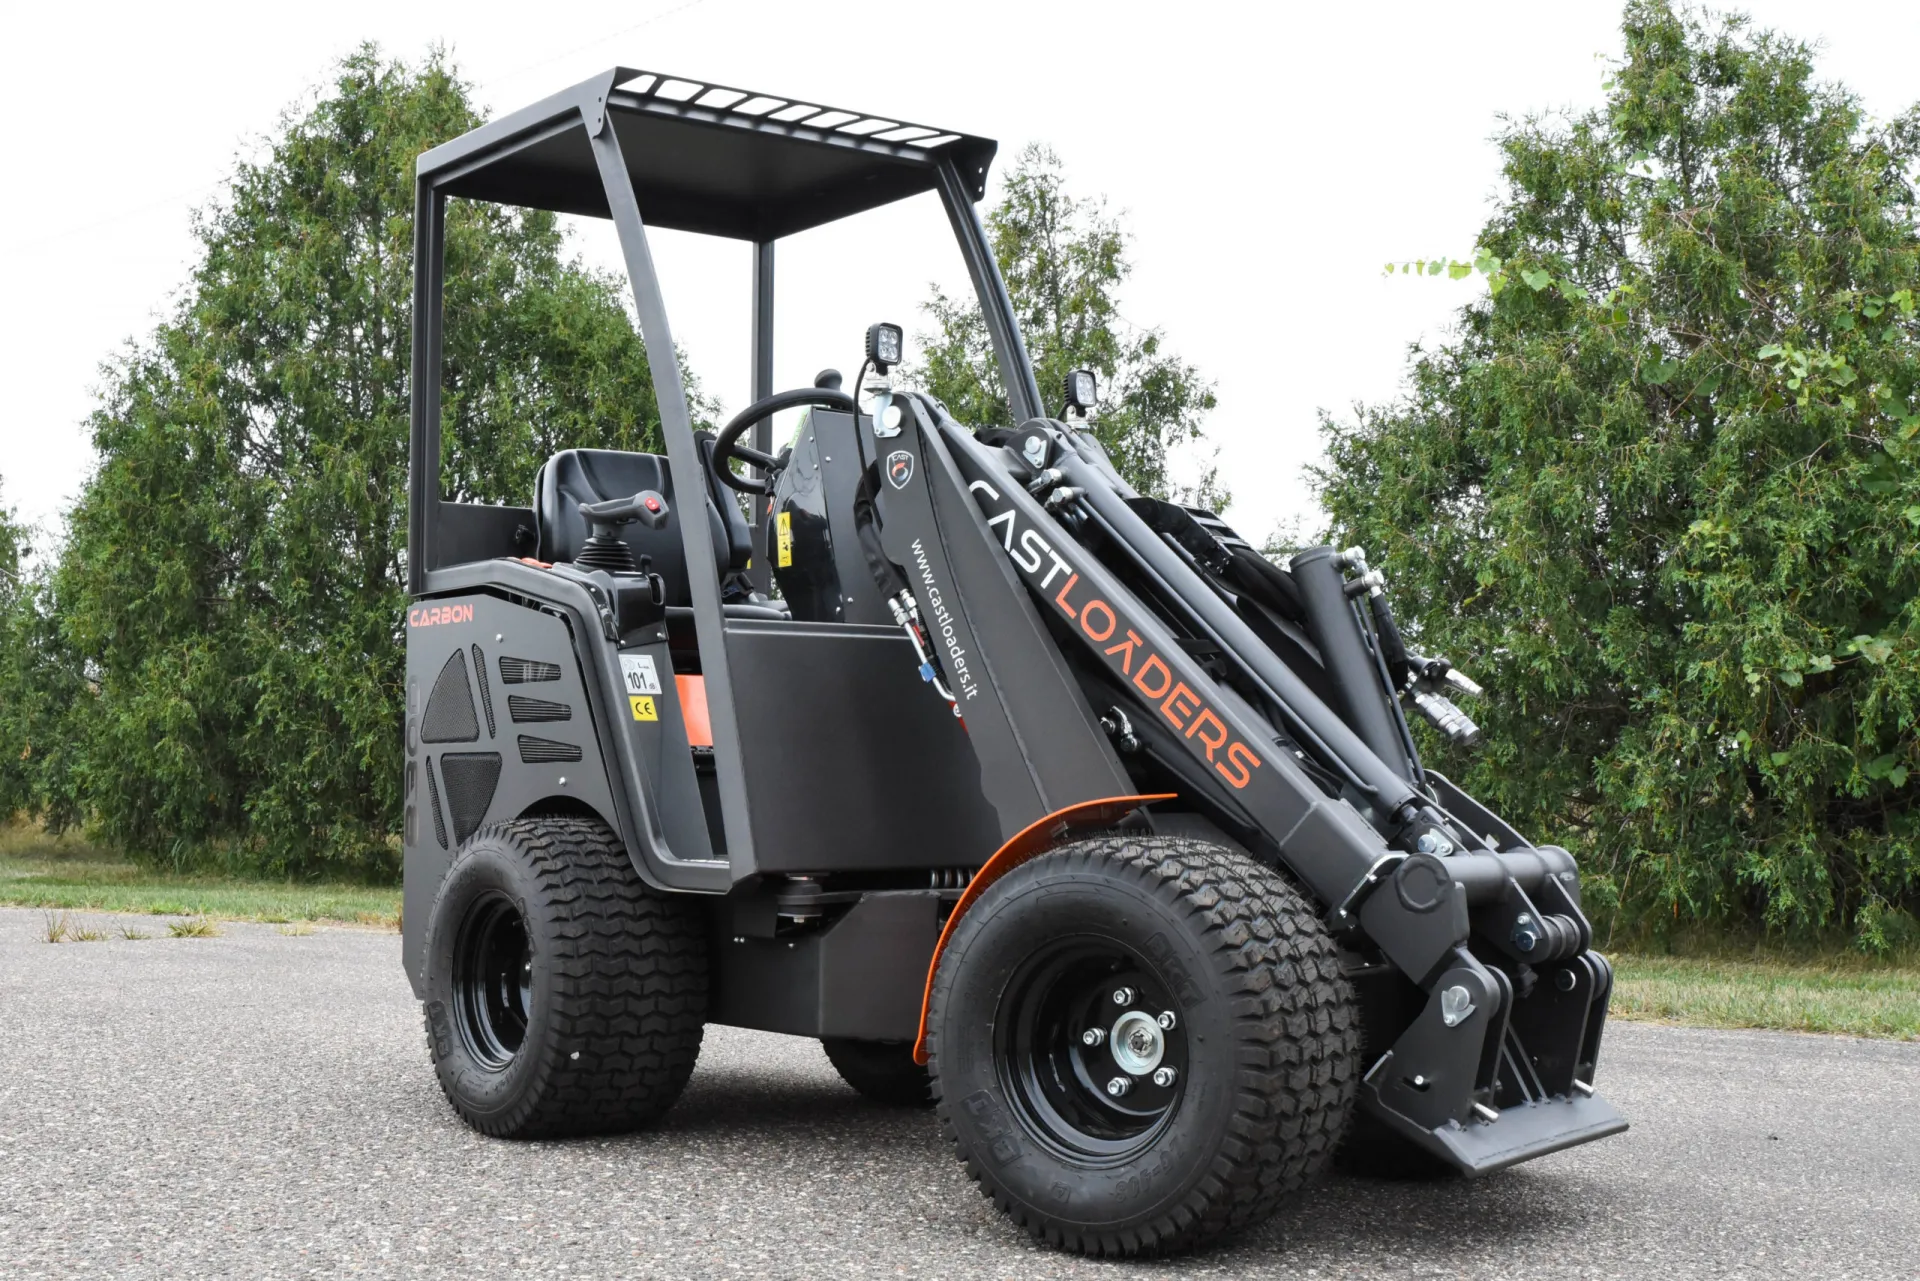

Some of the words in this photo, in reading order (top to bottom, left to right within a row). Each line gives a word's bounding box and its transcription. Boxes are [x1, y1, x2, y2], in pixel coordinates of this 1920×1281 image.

[410, 604, 473, 627] CARBON
[911, 538, 978, 700] www.castloaders.it
[628, 672, 647, 689] 101
[635, 702, 652, 715] CE
[964, 1095, 1018, 1162] BKT
